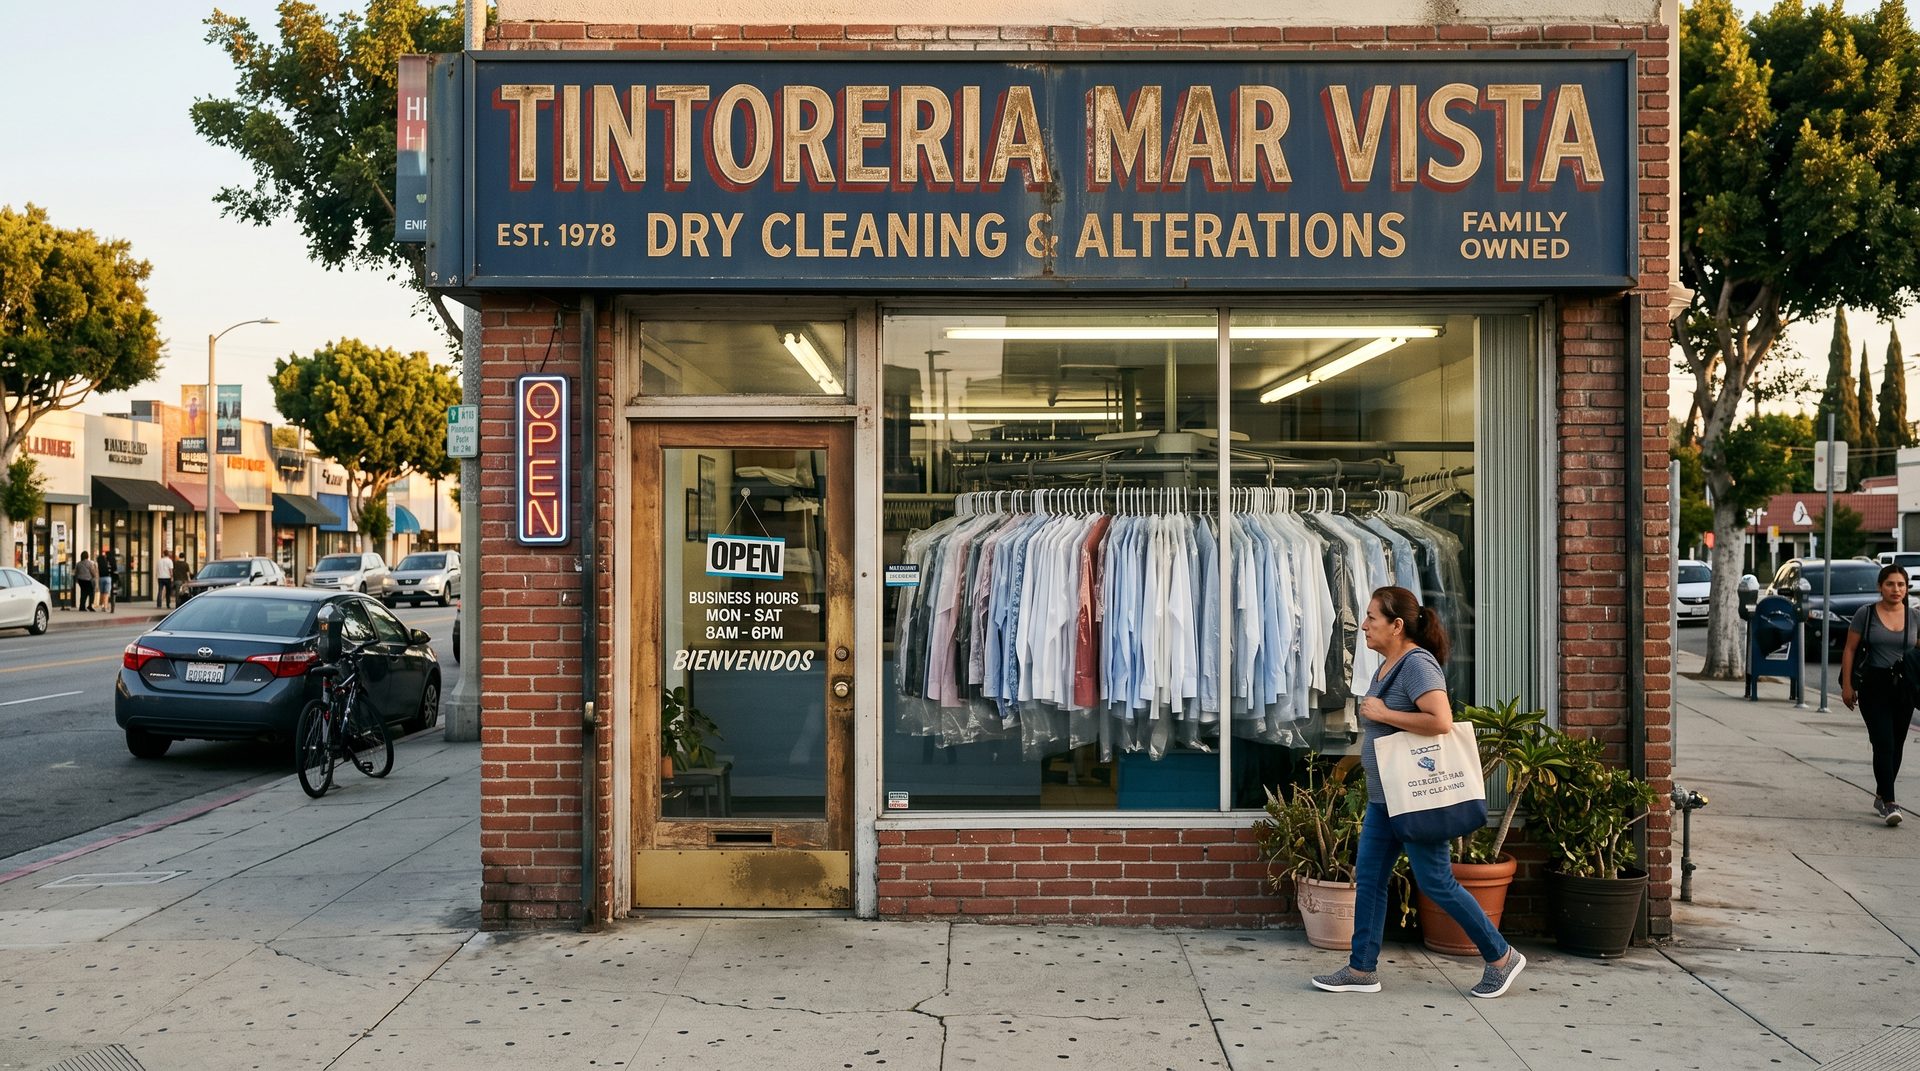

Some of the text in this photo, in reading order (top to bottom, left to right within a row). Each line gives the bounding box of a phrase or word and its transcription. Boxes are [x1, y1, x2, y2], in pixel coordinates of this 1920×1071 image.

[501, 83, 1605, 184] TINTORERIA MAR VISTA
[1462, 211, 1568, 234] FAMILY
[497, 223, 617, 247] EST. 1978
[646, 212, 1406, 258] DRY CLEANING & ALTERATIONS
[1460, 238, 1571, 260] OWNED
[526, 382, 560, 536] OPEN
[711, 540, 780, 573] OPEN
[689, 591, 799, 604] BUSINESS HOURS
[706, 608, 741, 622] MON
[754, 608, 782, 622] SAT
[705, 626, 739, 640] 8AM
[751, 626, 784, 640] 6PM
[672, 649, 815, 672] BIENVENIDOS
[1412, 789, 1428, 797] DRY
